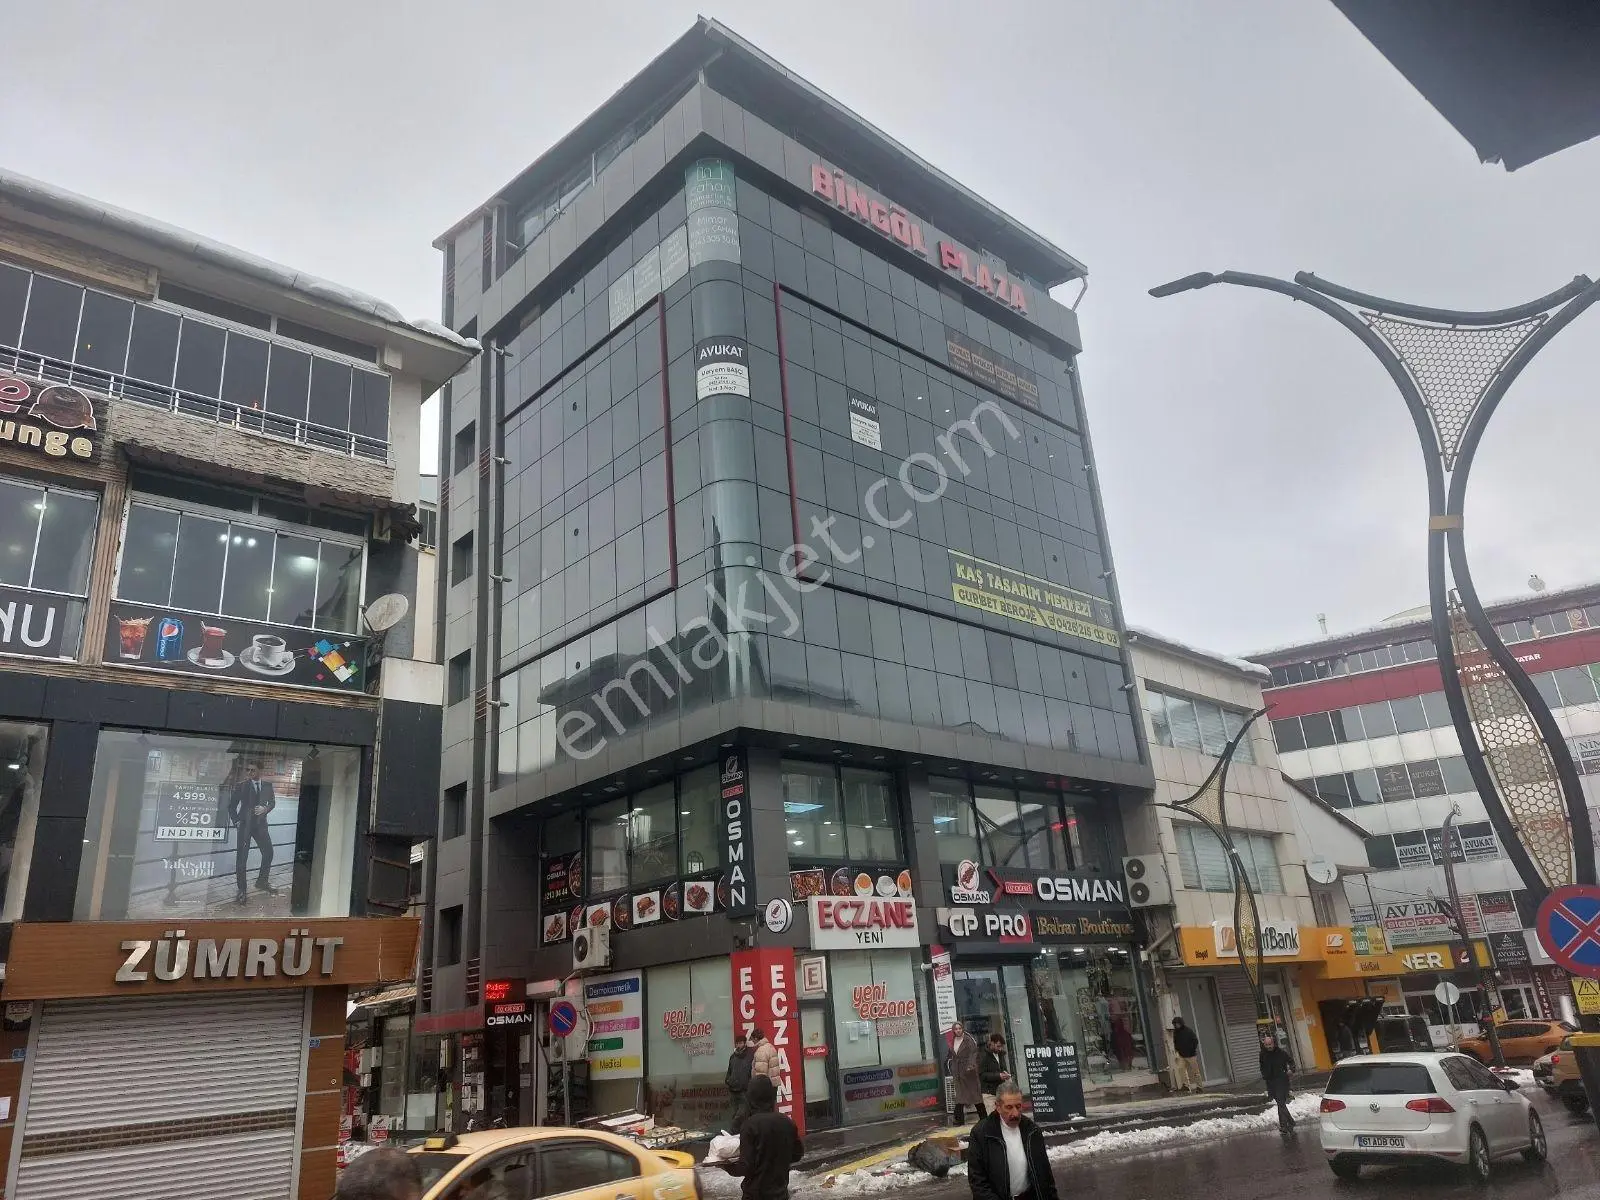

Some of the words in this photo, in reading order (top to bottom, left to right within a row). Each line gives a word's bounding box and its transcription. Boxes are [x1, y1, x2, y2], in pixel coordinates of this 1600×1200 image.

[811, 163, 928, 258] BİNGÖL
[937, 240, 1028, 316] PLAZA
[700, 345, 743, 360] AVUKAT
[851, 398, 876, 415] AVUKAT
[956, 563, 984, 589] KAŞ
[987, 573, 1042, 602] TASARIM
[958, 589, 1000, 610] GURBET
[175, 812, 211, 825] %50
[161, 828, 221, 839] İNDİRİM
[1399, 846, 1427, 858] AVUKAT
[1465, 837, 1494, 849] AVUKAT
[726, 800, 746, 907] OSMAN
[953, 892, 989, 902] OSMAN
[1037, 877, 1124, 902] OSMAN
[818, 900, 916, 930] ECZANE
[1385, 905, 1410, 919] AV
[950, 914, 978, 936] CP
[985, 914, 1027, 937] PRO
[856, 929, 884, 943] YENİ
[115, 928, 344, 982] ZÜMRÜT
[808, 967, 819, 986] E
[589, 981, 632, 997] Dermokozmetik
[853, 981, 889, 1009] yeni
[663, 1006, 688, 1028] yeni
[859, 1000, 918, 1020] eczane
[487, 1013, 532, 1026] OSMAN
[670, 1021, 713, 1040] eczane
[1026, 1048, 1036, 1059] CP
[1037, 1047, 1052, 1058] PRO
[1373, 1137, 1388, 1147] ADB
